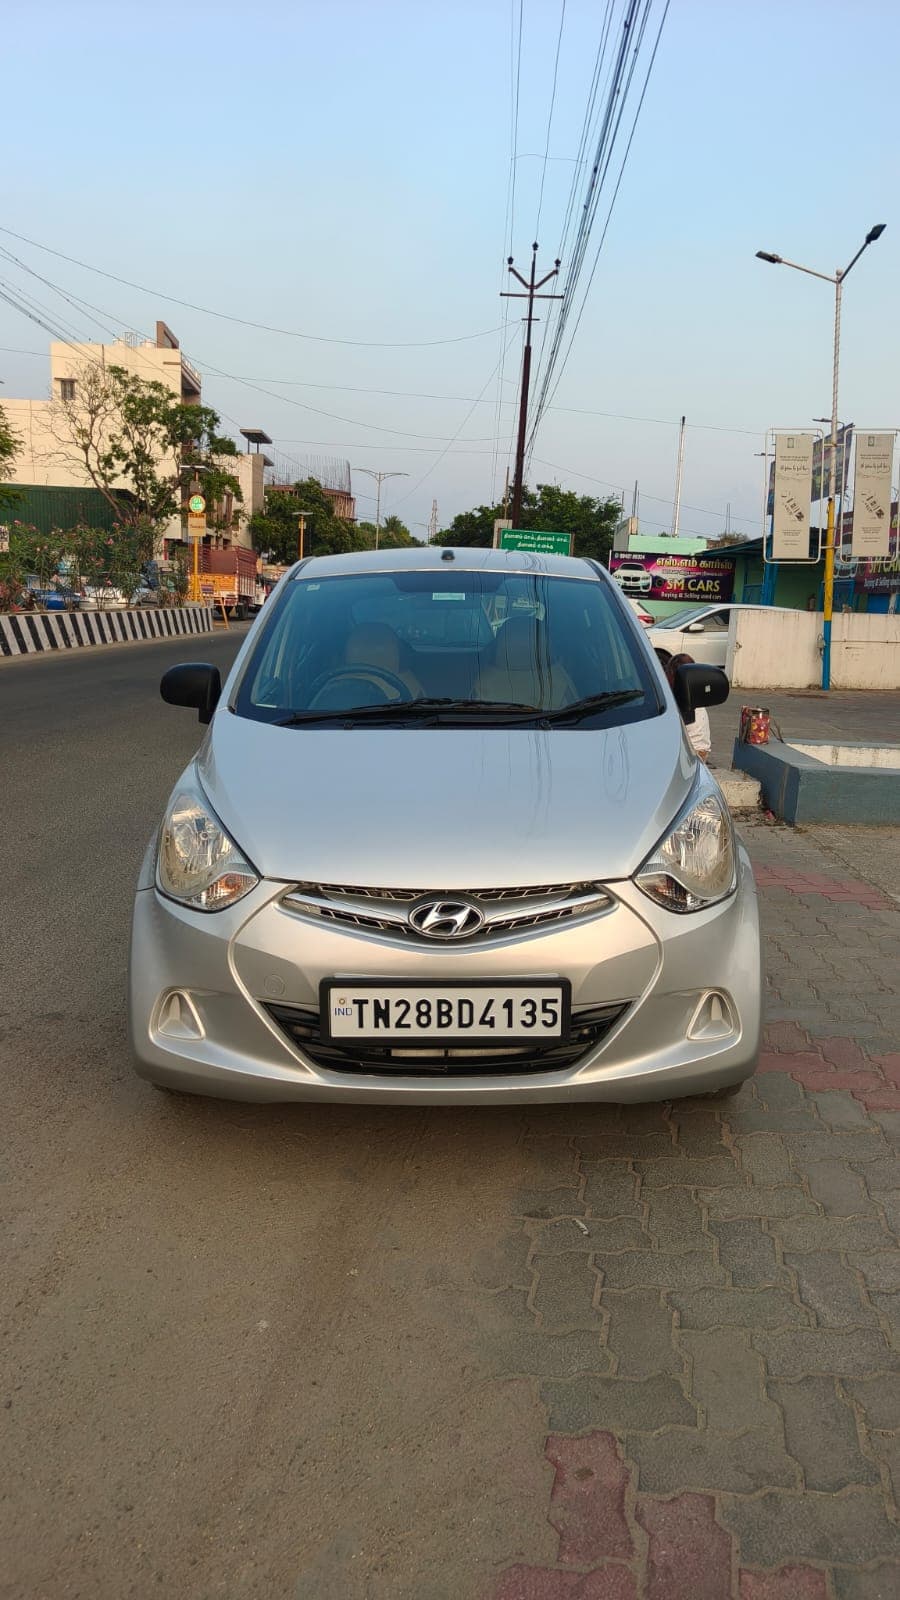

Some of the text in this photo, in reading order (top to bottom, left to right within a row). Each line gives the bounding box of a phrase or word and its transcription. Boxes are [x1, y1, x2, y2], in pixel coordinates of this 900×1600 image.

[666, 579, 720, 592] SM CARS
[334, 1007, 352, 1016] IND
[352, 998, 559, 1029] TN28BD4135
